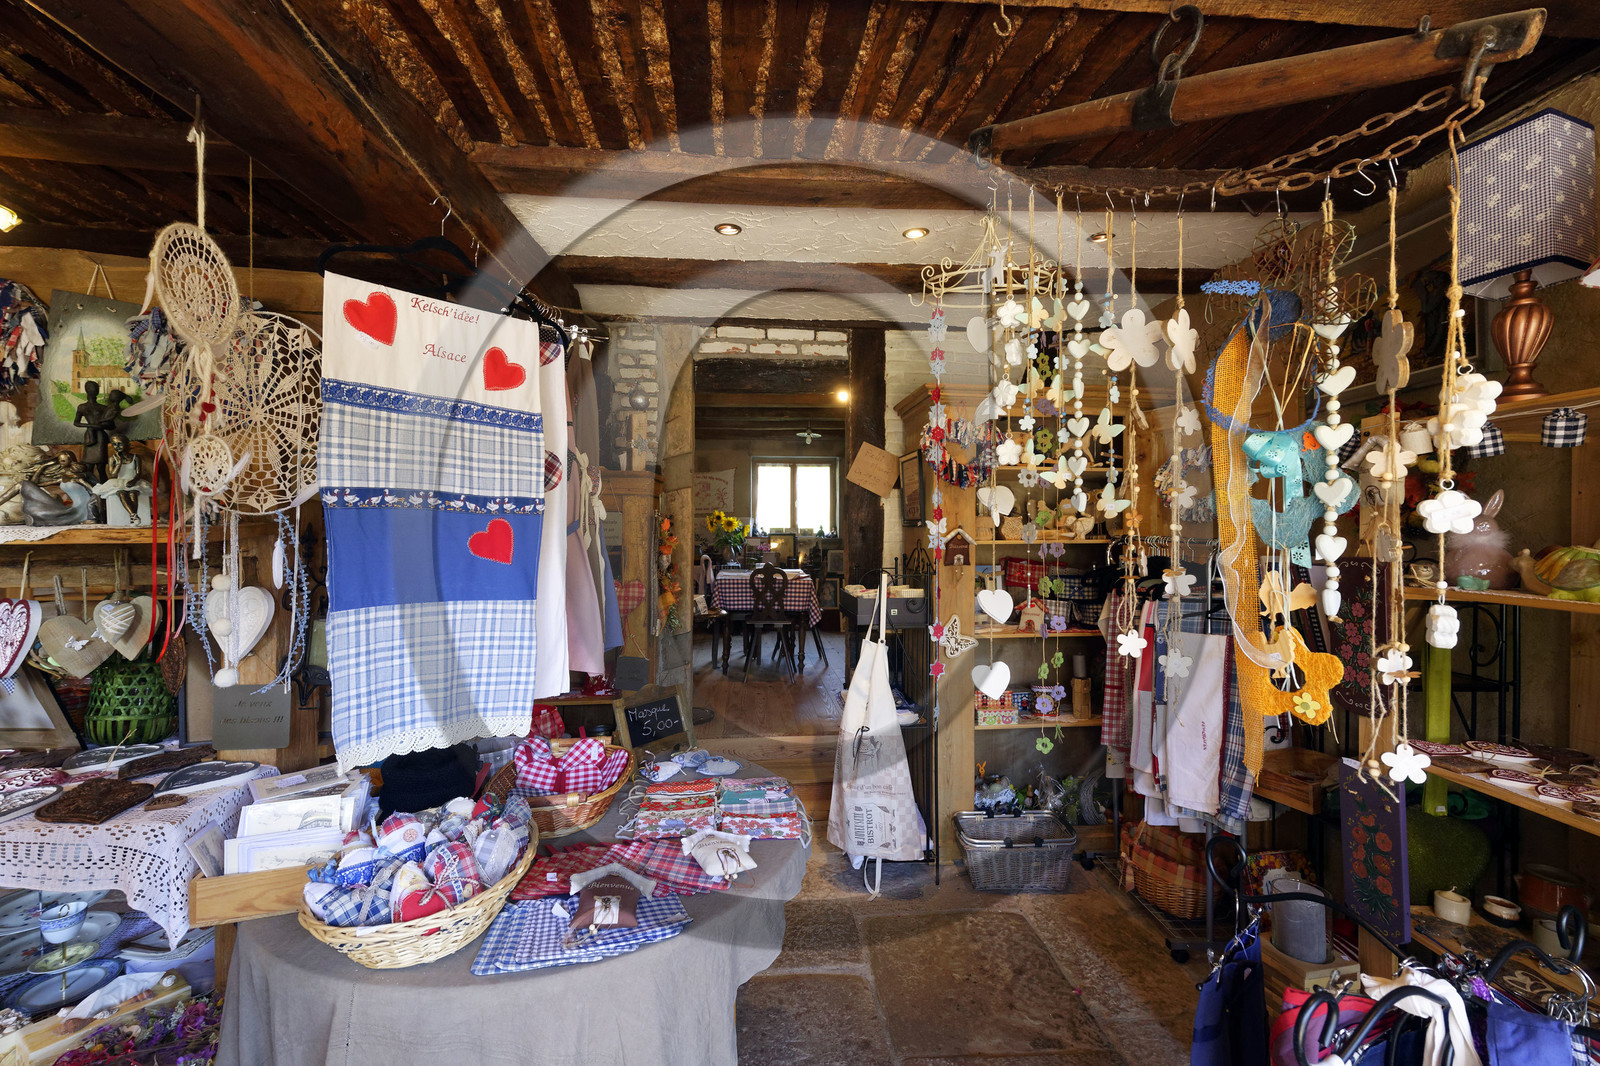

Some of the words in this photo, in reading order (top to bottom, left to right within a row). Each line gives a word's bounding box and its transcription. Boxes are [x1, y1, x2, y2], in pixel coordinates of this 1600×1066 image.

[422, 343, 467, 363] Alsace
[627, 703, 670, 722] Masque
[866, 808, 875, 845] BISTROT
[587, 881, 635, 891] Bienvenue
